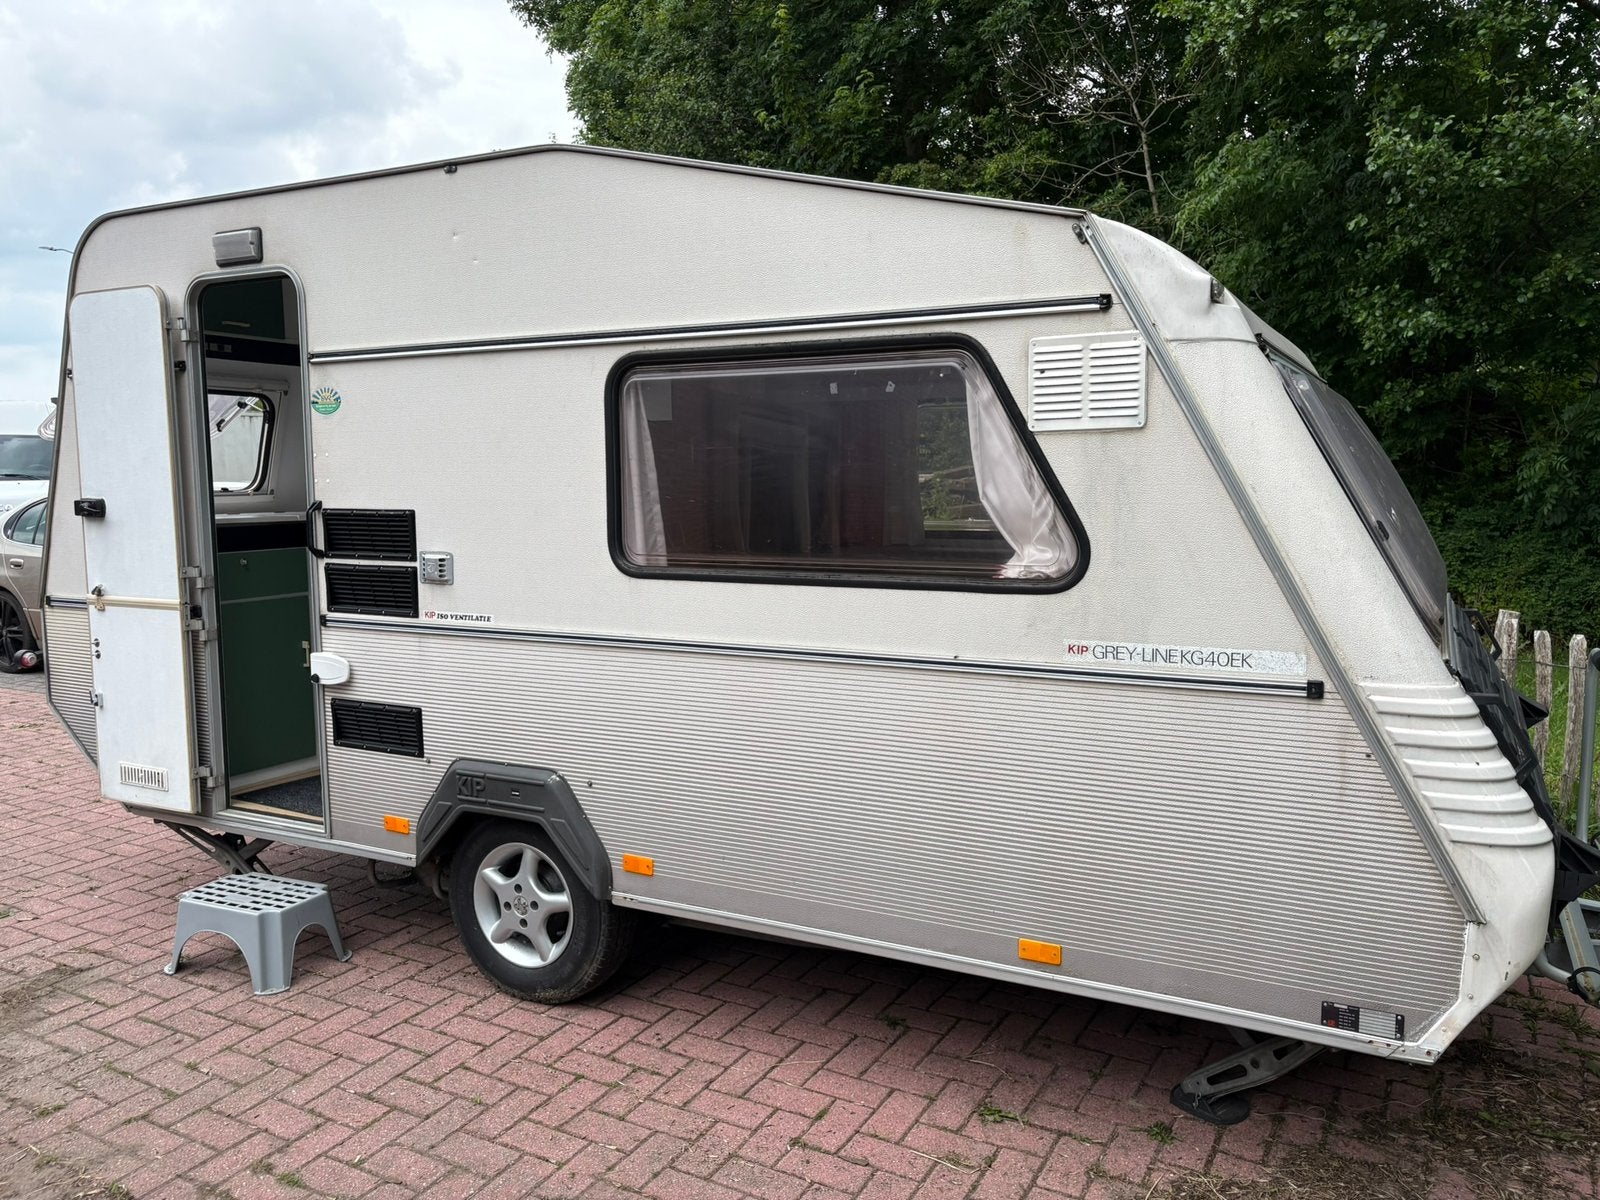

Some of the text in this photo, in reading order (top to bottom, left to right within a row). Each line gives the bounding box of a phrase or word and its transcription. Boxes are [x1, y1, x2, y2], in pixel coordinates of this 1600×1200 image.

[424, 610, 492, 623] KIP ISO VENTILATIE
[1067, 643, 1089, 656] KIP
[457, 776, 486, 797] KIP
